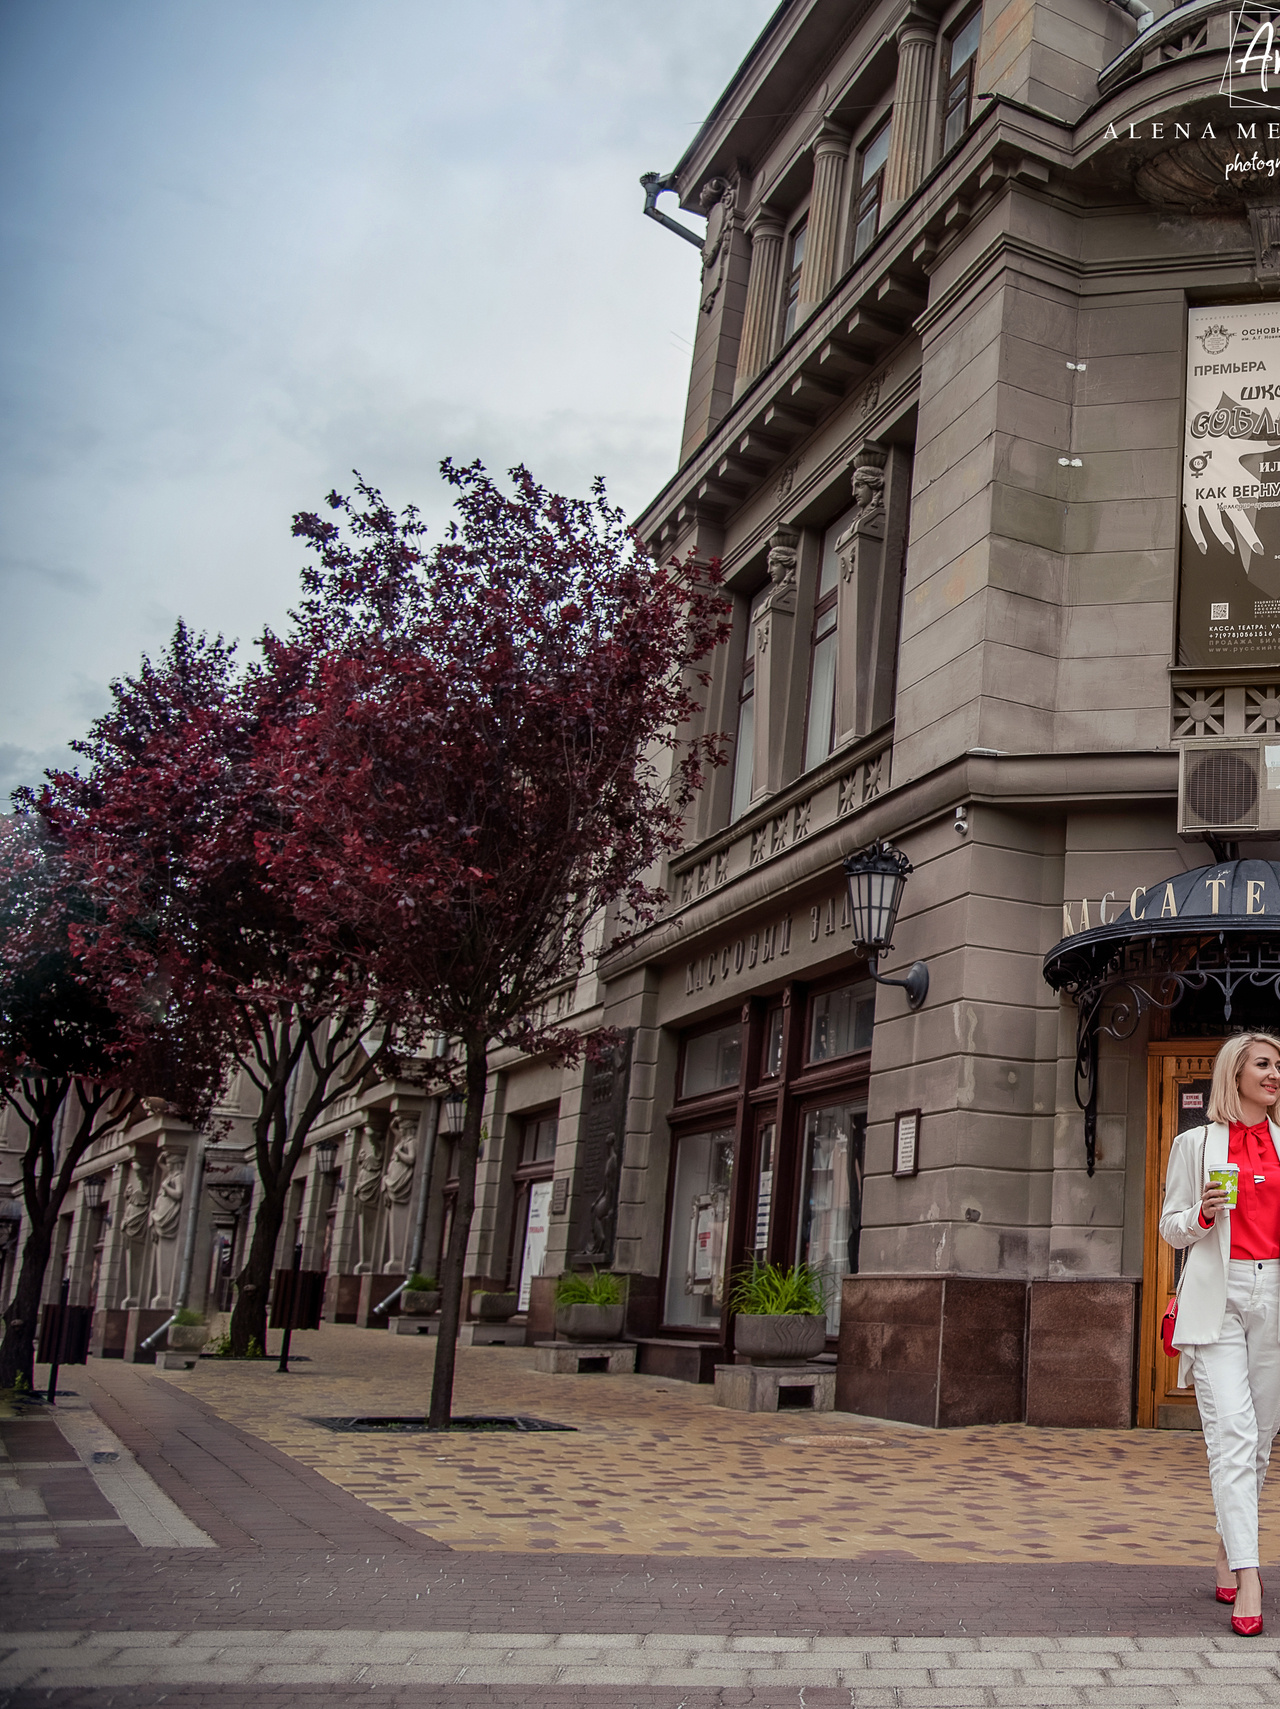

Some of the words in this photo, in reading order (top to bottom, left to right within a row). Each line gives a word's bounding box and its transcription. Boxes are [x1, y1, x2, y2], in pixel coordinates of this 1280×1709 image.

[1194, 360, 1267, 377] ПРЕМЬЕРА
[1195, 486, 1227, 500] КАК
[1208, 638, 1253, 646] ПРОДАЖА
[1062, 882, 1179, 938] КАССА
[685, 912, 793, 996] КАССОВЫЙ
[809, 891, 852, 942] ЗАЛ
